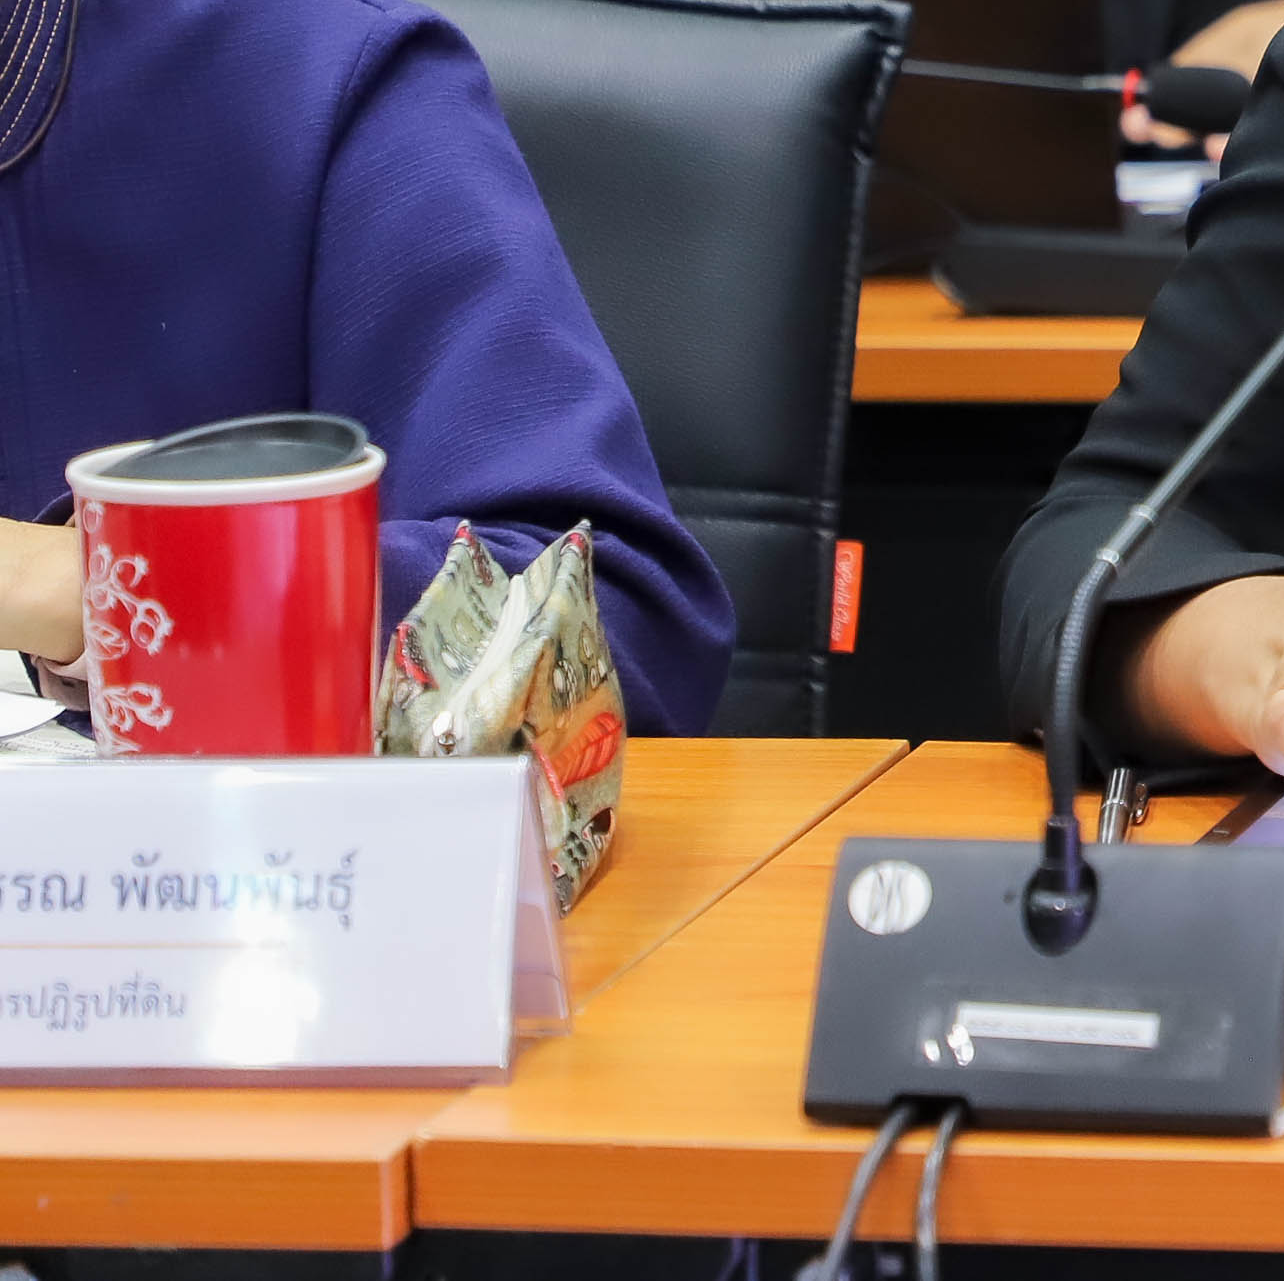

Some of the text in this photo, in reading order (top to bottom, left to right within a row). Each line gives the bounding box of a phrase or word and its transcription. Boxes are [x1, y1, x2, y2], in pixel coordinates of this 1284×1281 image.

[0, 871, 88, 912] รณ
[0, 971, 188, 1032] รปฏิรูปที่ดิน
